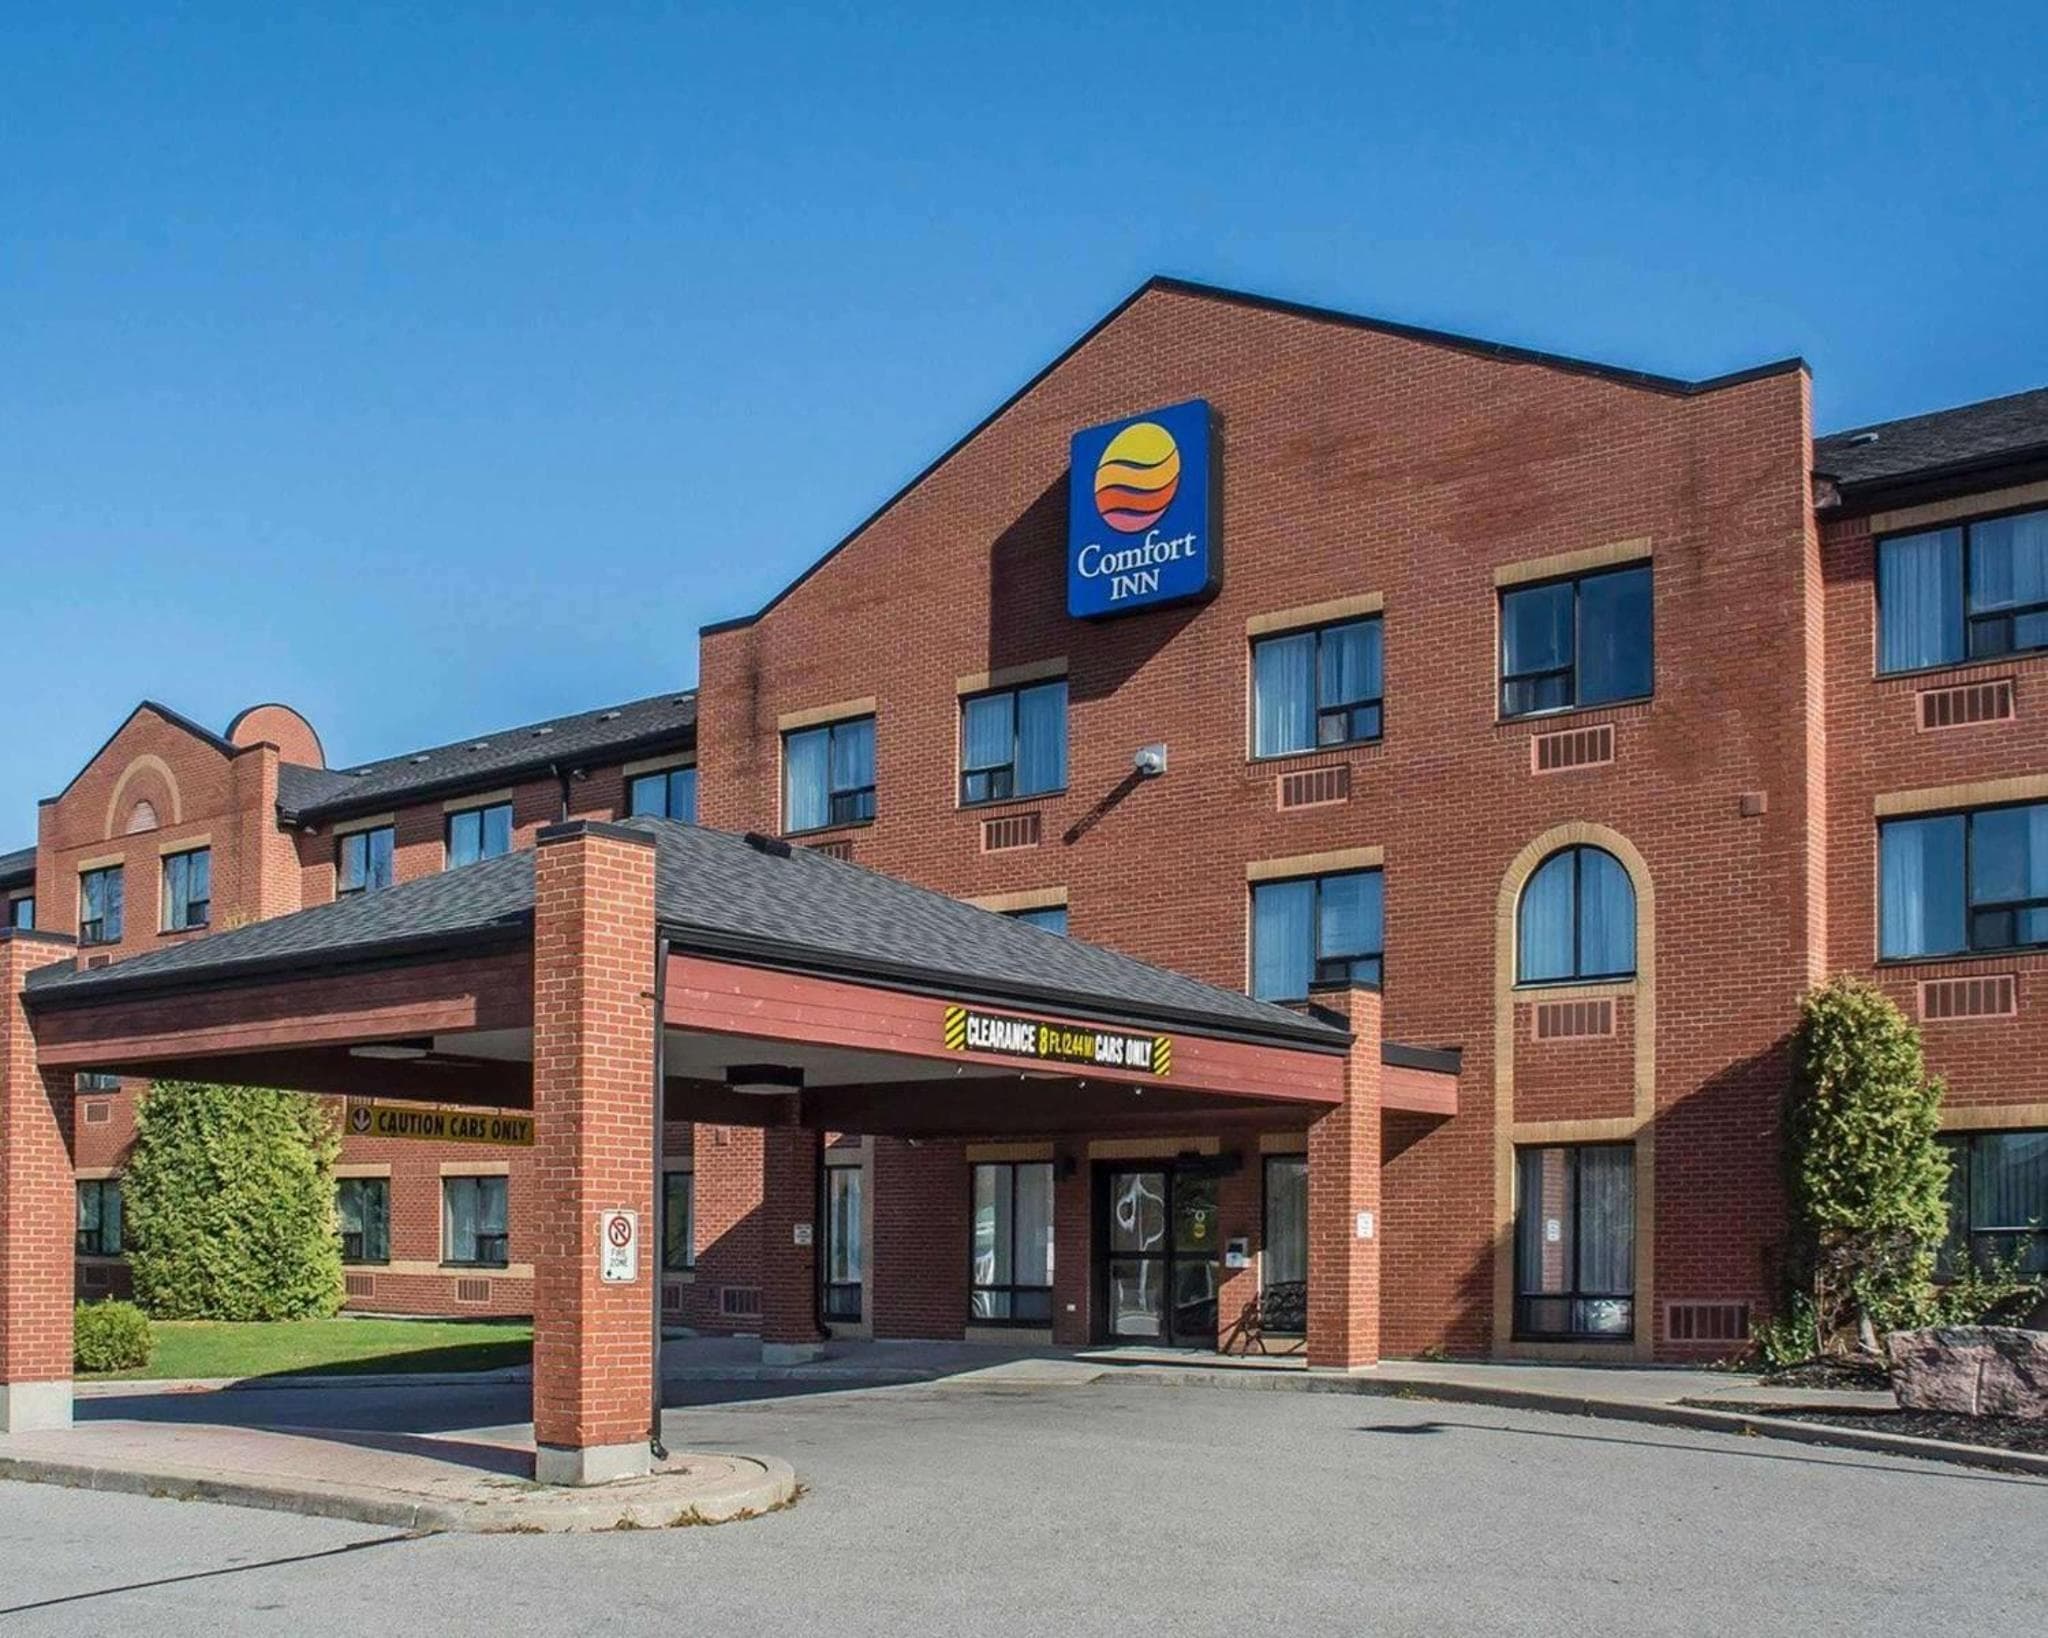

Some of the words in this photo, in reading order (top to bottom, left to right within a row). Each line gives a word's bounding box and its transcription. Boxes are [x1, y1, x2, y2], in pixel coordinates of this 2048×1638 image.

[1078, 529, 1197, 578] Comfort
[1110, 569, 1160, 600] INN
[967, 1016, 1036, 1053] CLEARANCE
[1039, 1027, 1048, 1055] 8
[1095, 1034, 1124, 1064] CARS
[1125, 1039, 1152, 1066] ONLY
[379, 1111, 444, 1136] CAUTION
[451, 1117, 486, 1138] CARS
[491, 1120, 529, 1140] ONLY
